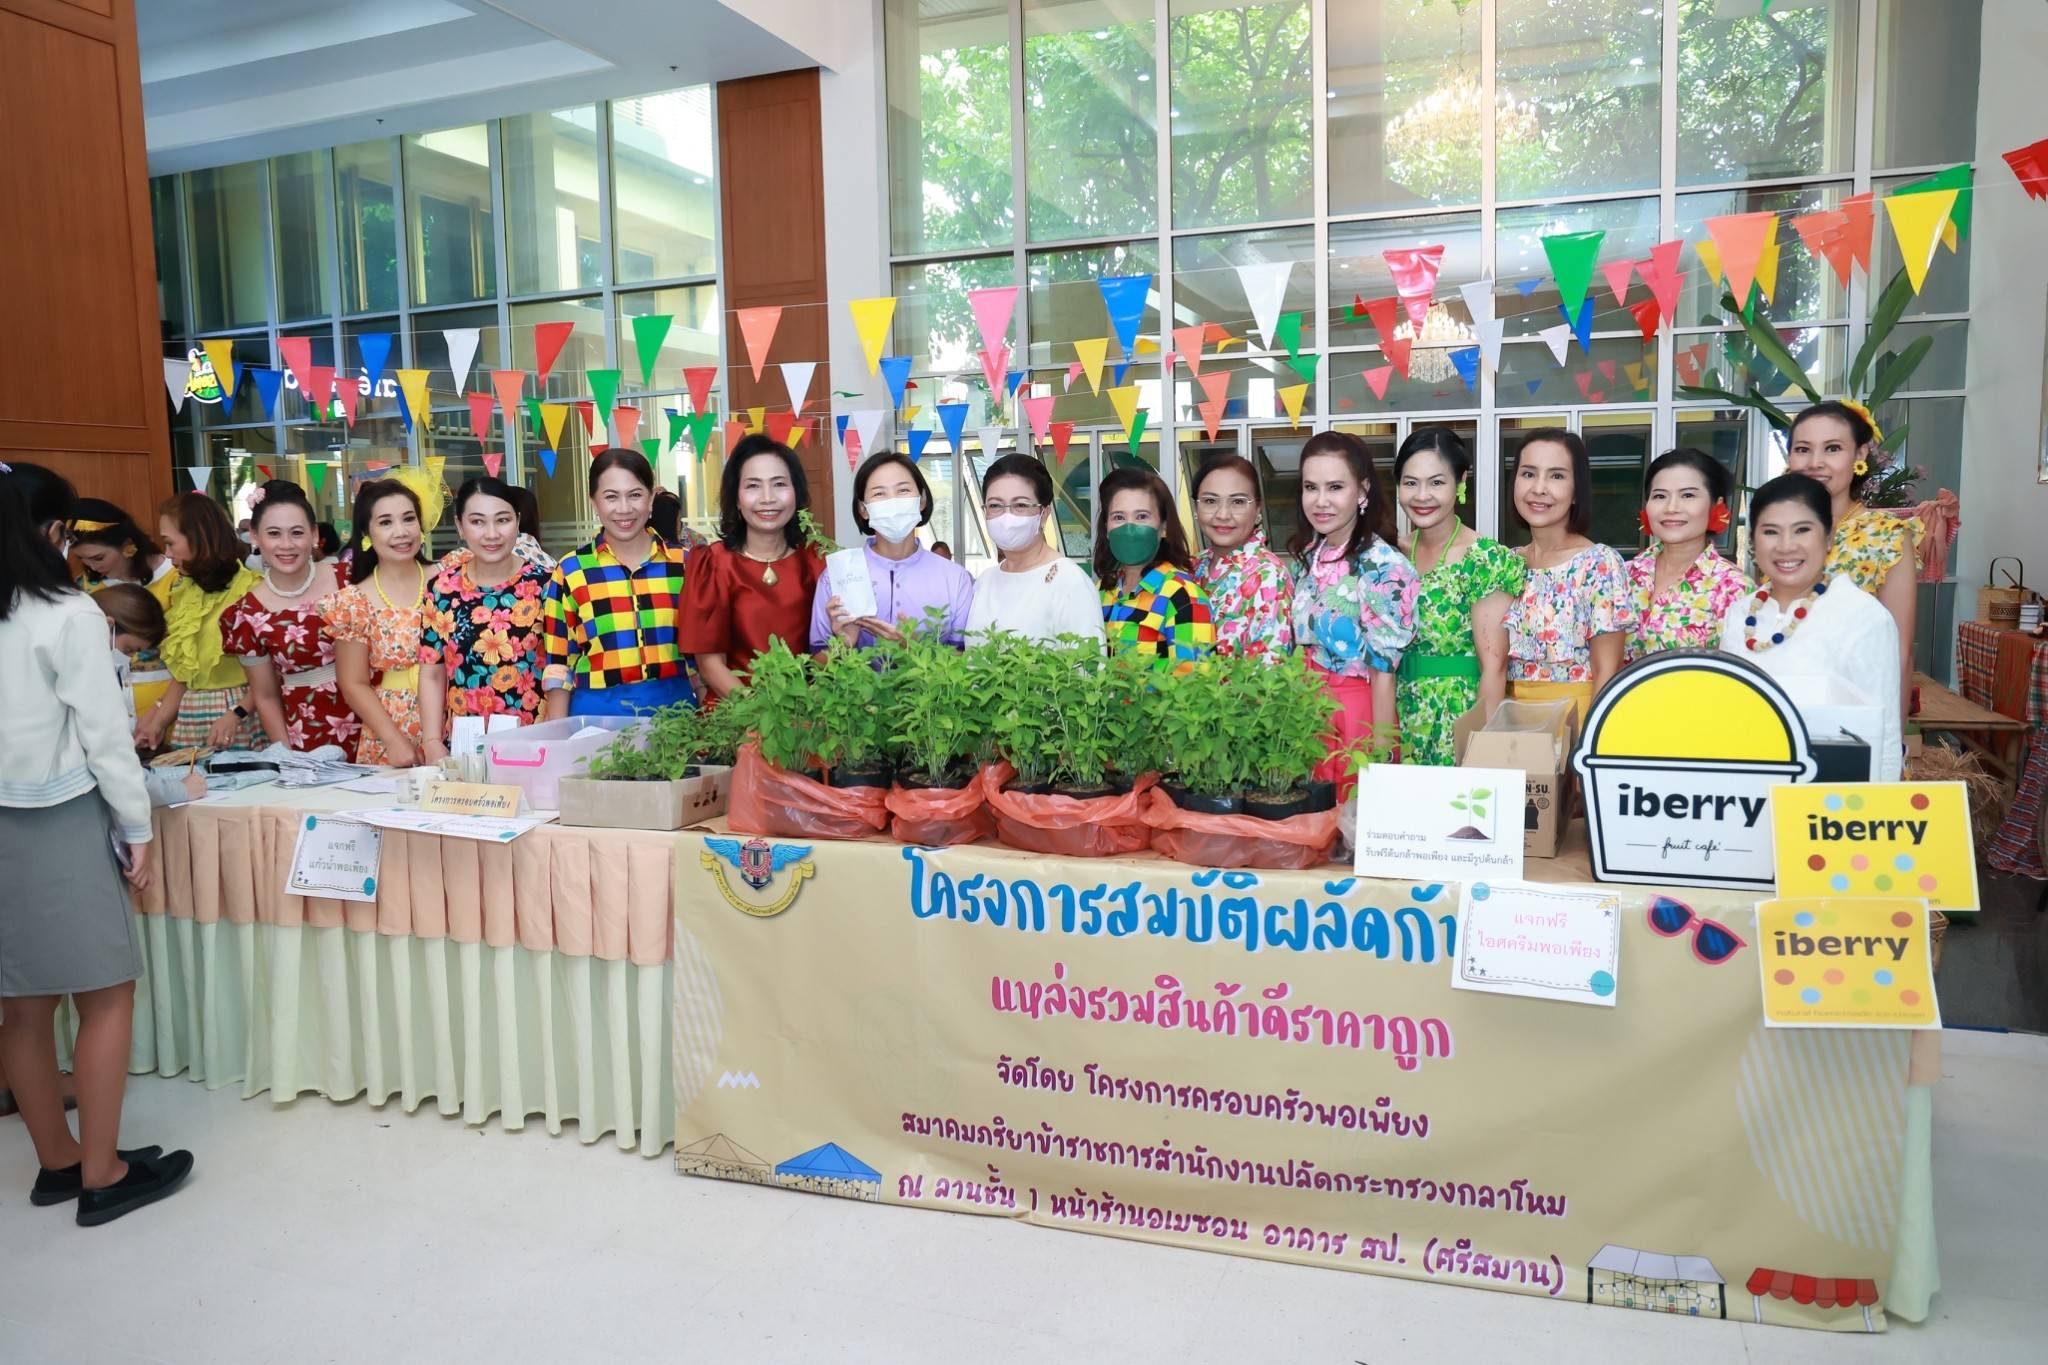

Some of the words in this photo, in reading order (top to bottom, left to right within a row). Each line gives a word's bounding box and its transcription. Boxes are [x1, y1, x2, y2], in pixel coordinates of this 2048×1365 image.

[1618, 783, 1766, 827] iberry
[1661, 837, 1691, 859] fruit
[1807, 814, 1928, 845] iberry
[1514, 911, 1569, 928] แจกฟรี
[1477, 930, 1602, 959] ไอศครีมพอเพียง
[1774, 931, 1910, 961] iberry
[992, 963, 1452, 1072] แหล่งรวมสินค้าดีราคาถูก
[997, 1055, 1075, 1093] จัดโดย
[1084, 1063, 1429, 1138] โครงการครอบครัวพอเพียง
[901, 1112, 1567, 1217] สมาคมภริยาข้าราชการสำนักงานปลัดกระทรวงกลาโหม
[898, 1174, 922, 1198] ณ
[935, 1164, 1016, 1208] ลานชั้น
[1051, 1188, 1248, 1241] หน้าร้านอเมซอน
[1264, 1222, 1348, 1255] อาคาร
[1361, 1232, 1406, 1264] สป.
[1423, 1237, 1564, 1295] (ศรีสมาน)
